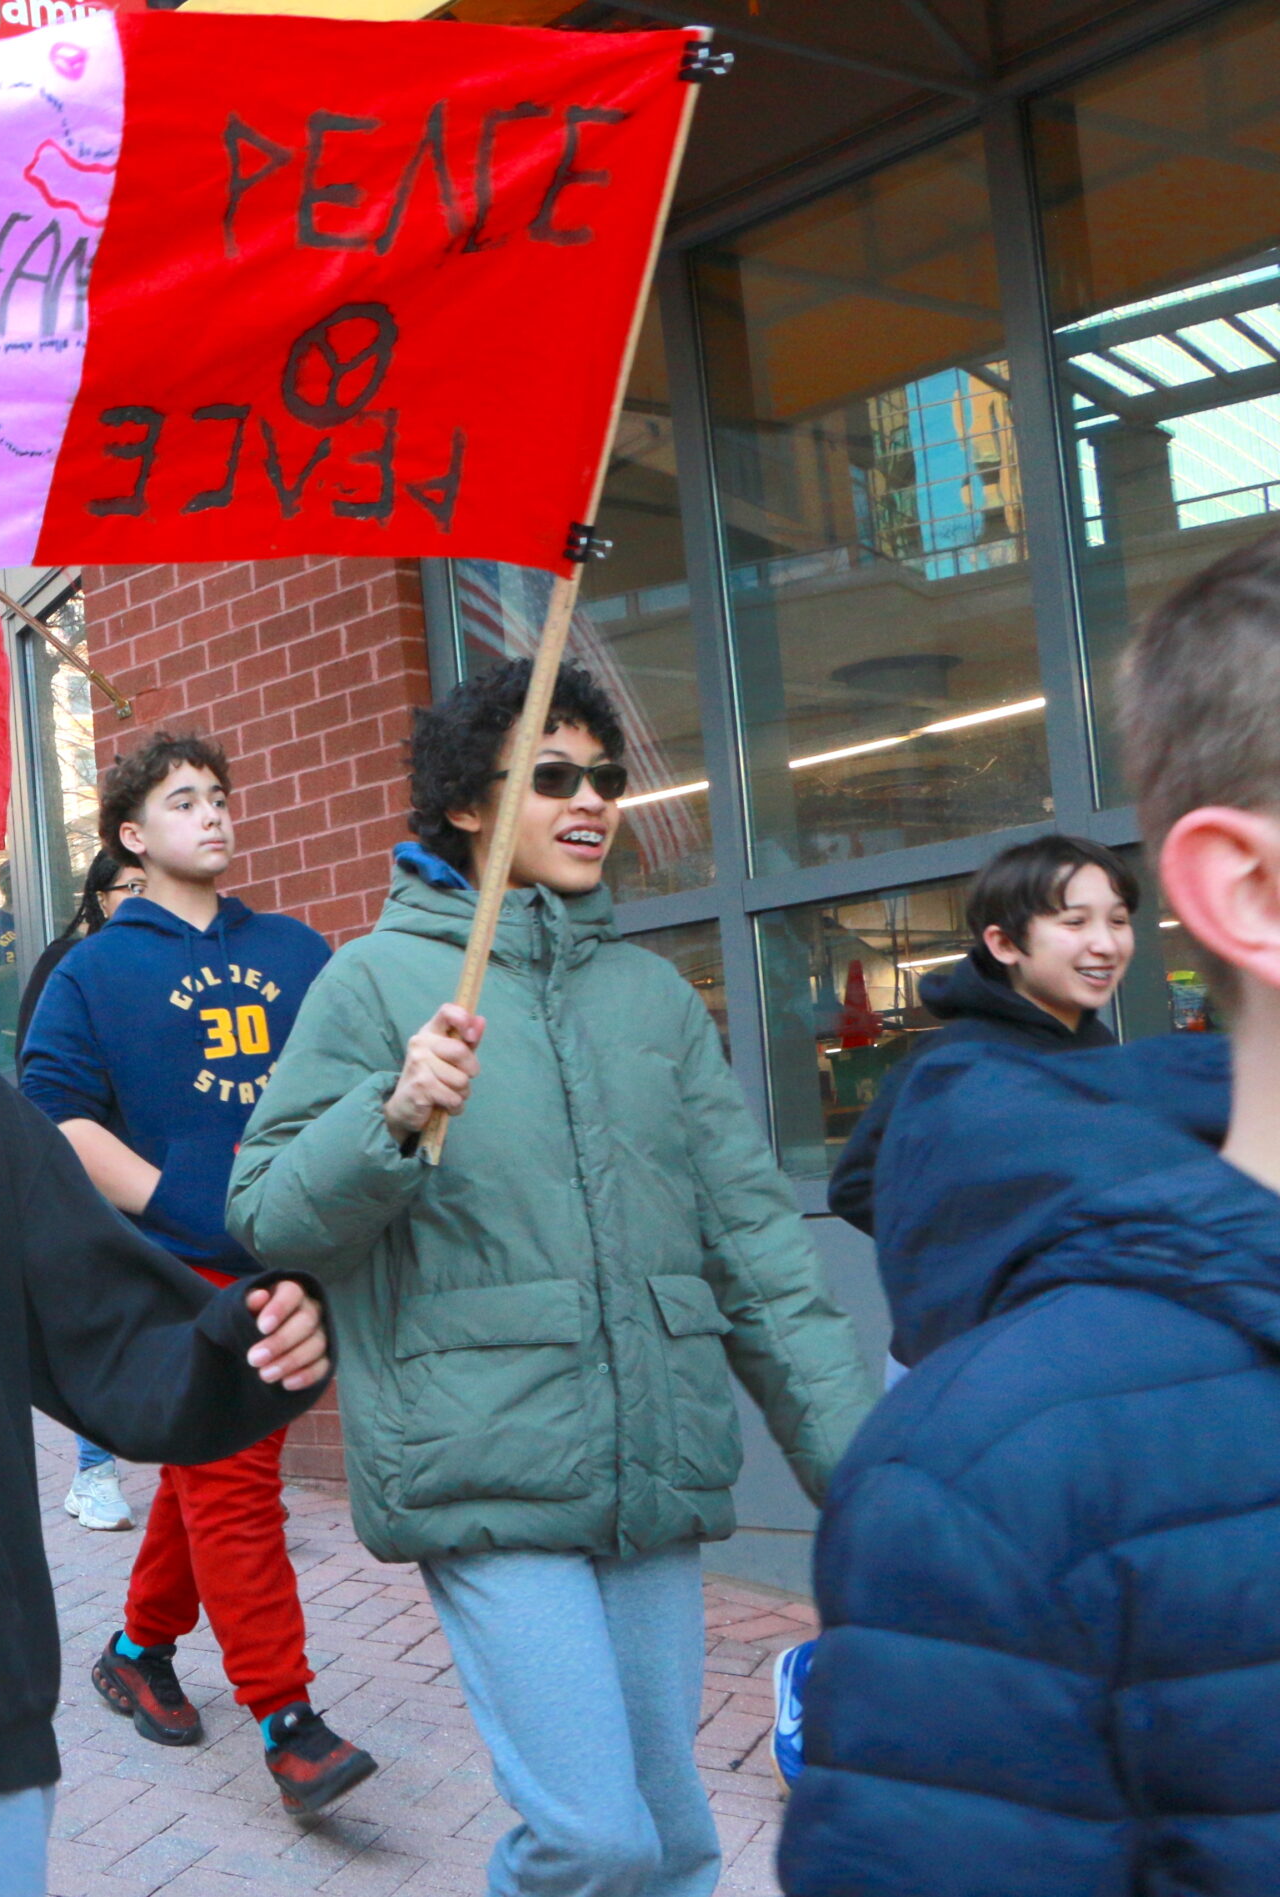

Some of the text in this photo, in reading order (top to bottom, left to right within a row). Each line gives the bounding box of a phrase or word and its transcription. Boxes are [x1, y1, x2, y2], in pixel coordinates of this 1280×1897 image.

[86, 402, 467, 534] PEACE
[199, 1003, 271, 1060] 30
[193, 1061, 277, 1104] STAT
